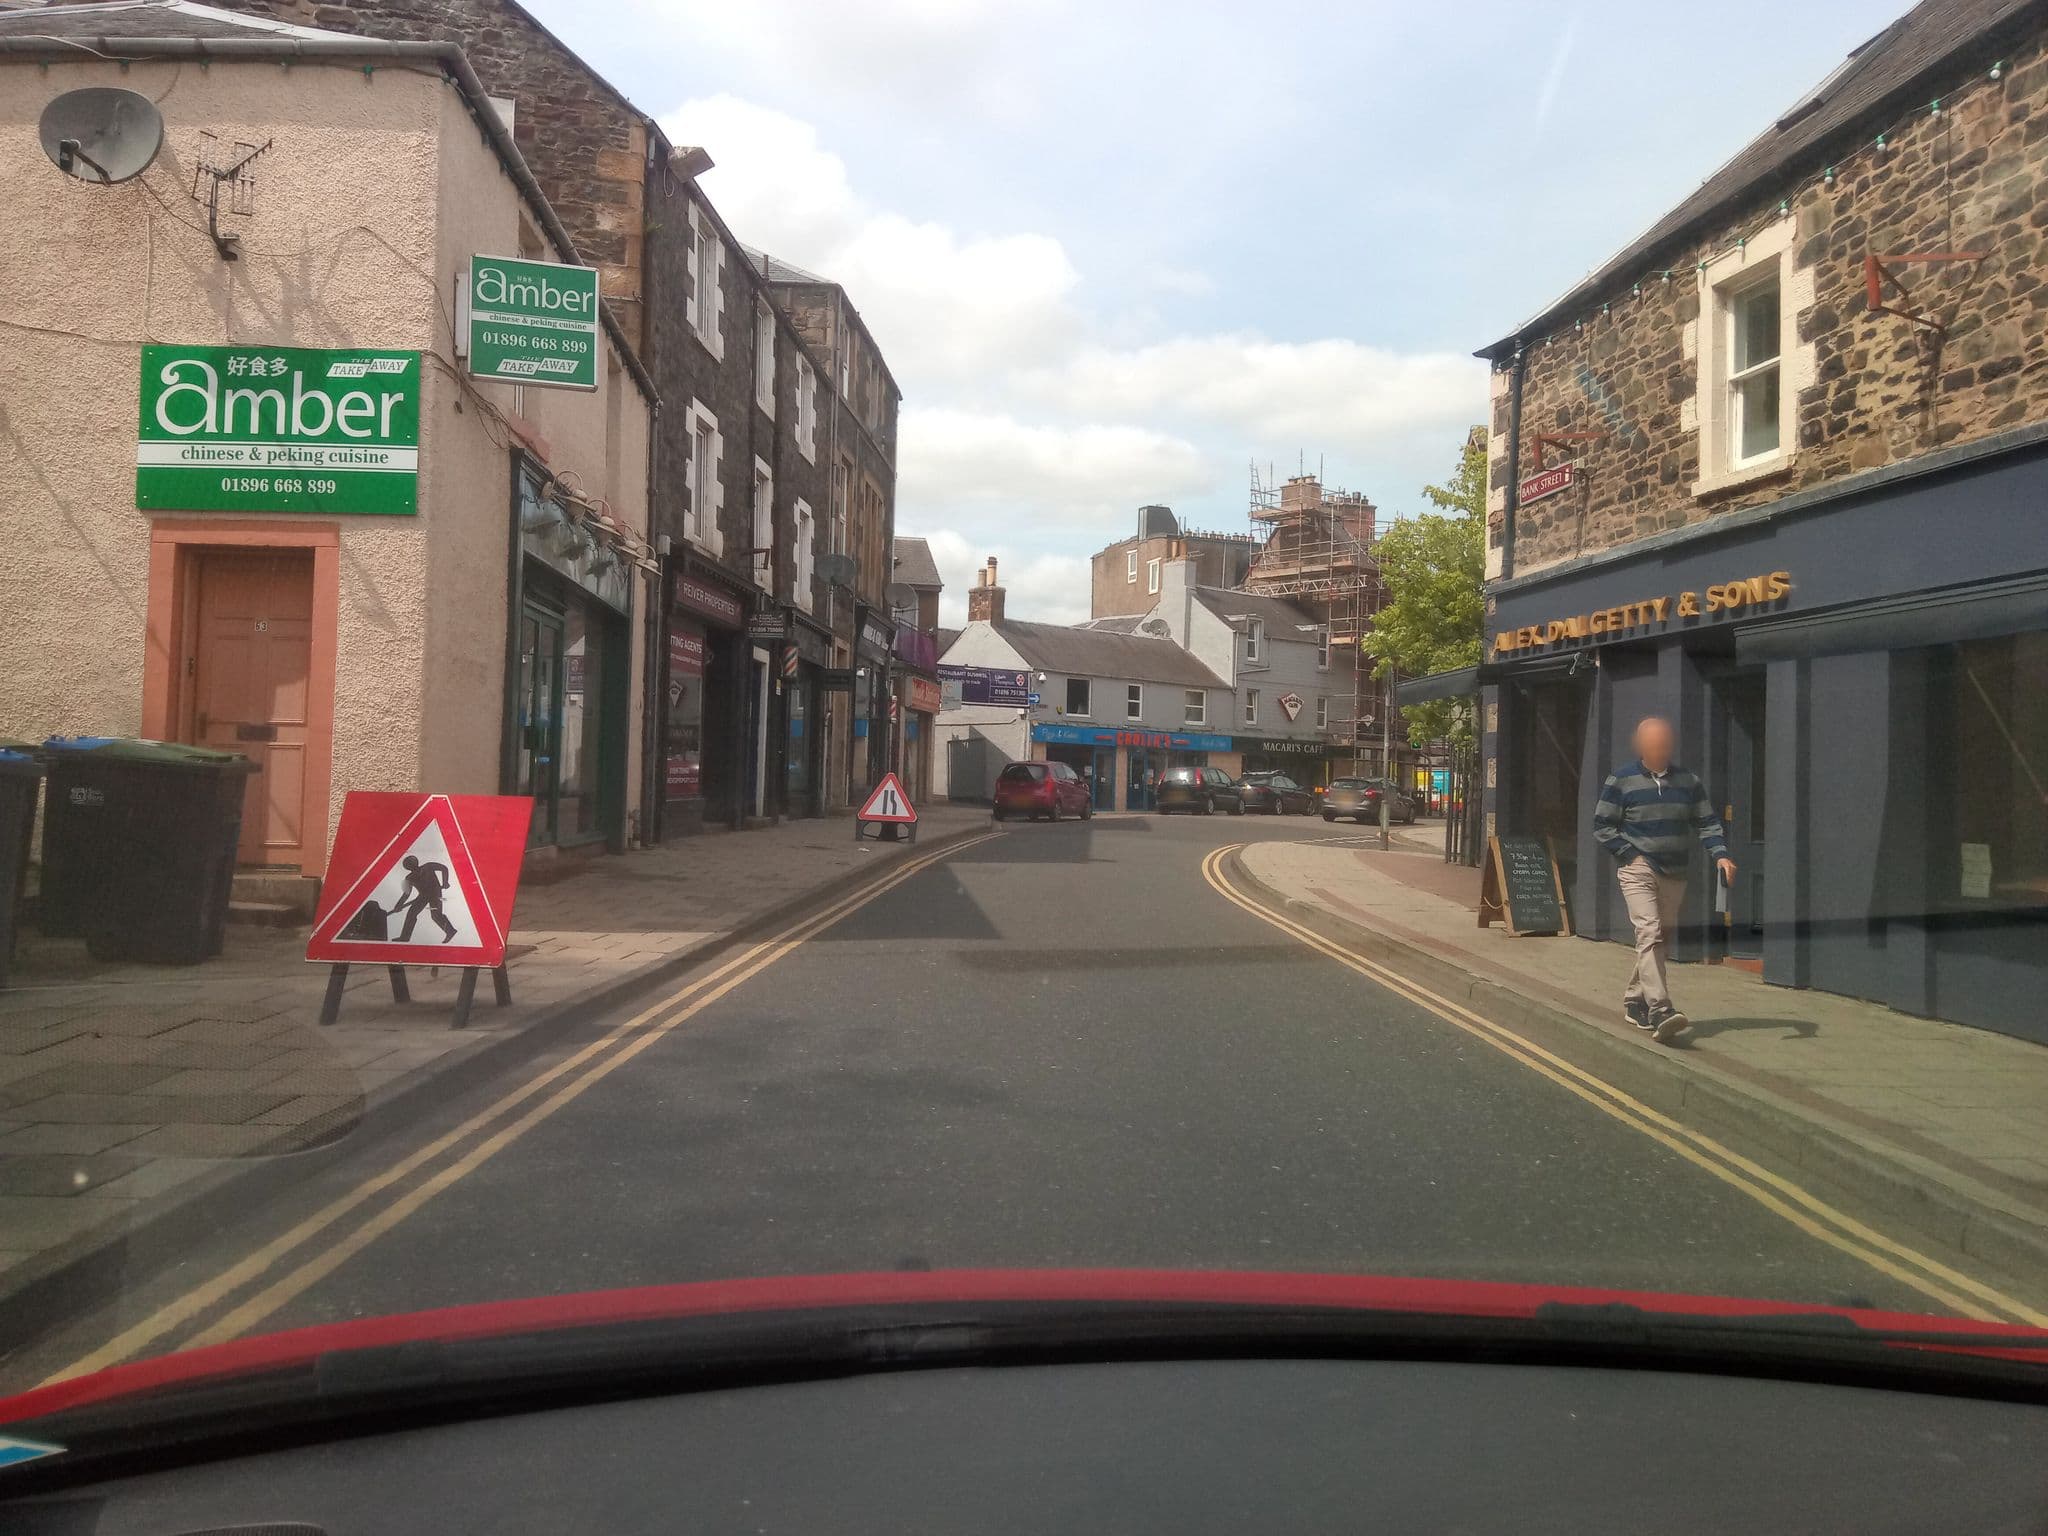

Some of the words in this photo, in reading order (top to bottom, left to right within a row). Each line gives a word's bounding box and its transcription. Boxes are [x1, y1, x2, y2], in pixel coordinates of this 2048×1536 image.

[476, 267, 593, 312] amber
[489, 313, 520, 323] chinese
[530, 317, 558, 328] peking
[559, 321, 587, 331] cuisine
[482, 331, 527, 347] 01896
[531, 336, 557, 351] 668
[562, 340, 588, 353] 899
[227, 356, 289, 377] 好食多
[332, 365, 364, 375] TAKE
[371, 360, 403, 371] AWAY
[503, 361, 534, 373] TAKE
[541, 360, 574, 371] AWAY
[155, 359, 404, 438] amber
[181, 446, 244, 461] chinese
[249, 446, 262, 461] &
[267, 448, 325, 465] peking
[329, 449, 389, 464] cuisine
[221, 477, 269, 493] 01896
[274, 478, 303, 493] 668
[307, 479, 336, 494] 899
[1521, 481, 1540, 499] BANK
[1540, 472, 1563, 490] STREET
[683, 583, 704, 603] REIVER
[704, 592, 735, 616] PROPERTIES
[1547, 597, 1672, 642] DALGETTY
[1677, 592, 1701, 617] &
[1705, 570, 1792, 612] SONS
[684, 639, 702, 654] AGENTS
[1263, 742, 1301, 752] MACARI'S
